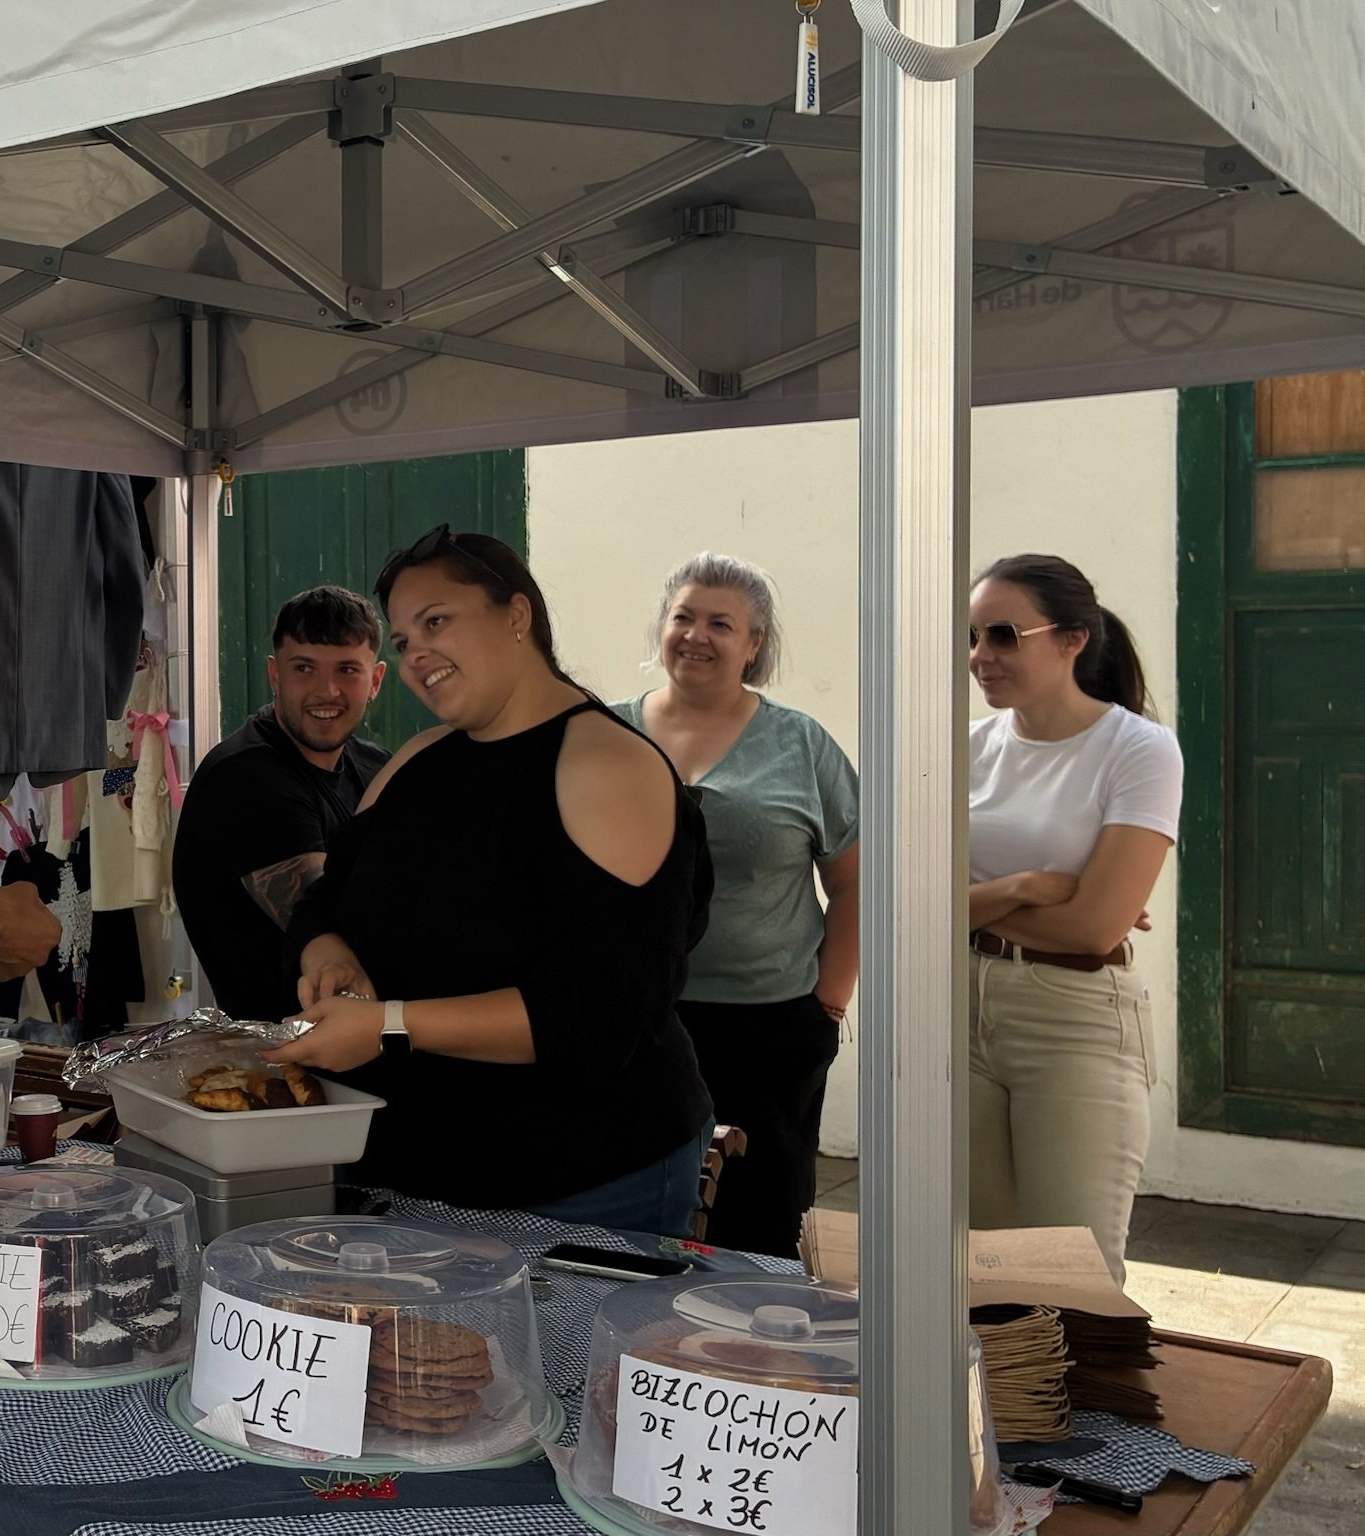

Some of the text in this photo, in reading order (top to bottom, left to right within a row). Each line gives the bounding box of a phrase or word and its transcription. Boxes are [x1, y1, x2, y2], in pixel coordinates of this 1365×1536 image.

[807, 51, 817, 110] ALUCISOL
[210, 1302, 337, 1378] COOKIE
[630, 1369, 847, 1442] BIZCOCHÓN
[639, 1411, 676, 1440] DE
[660, 1453, 684, 1480] 1
[728, 1468, 774, 1494] 2€
[661, 1486, 684, 1513] 2
[727, 1496, 773, 1531] 3€
